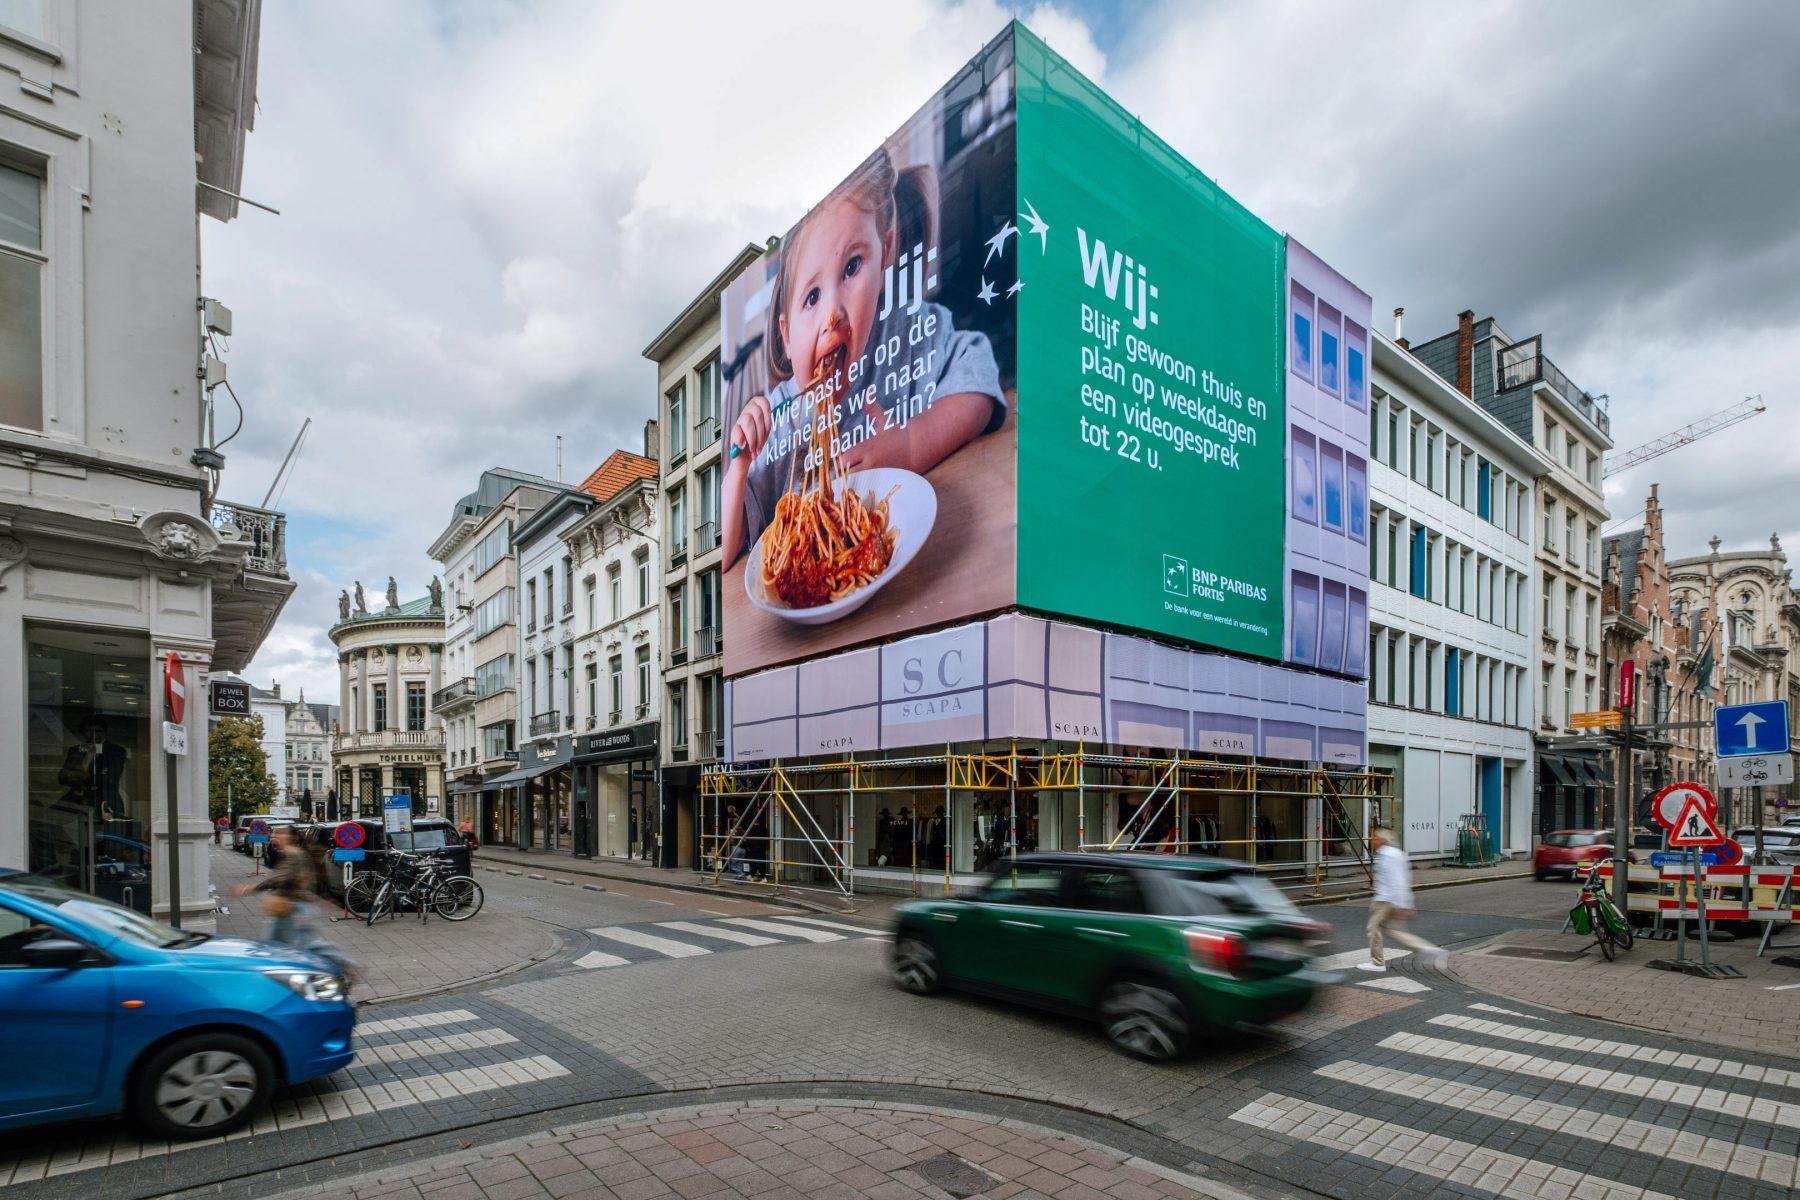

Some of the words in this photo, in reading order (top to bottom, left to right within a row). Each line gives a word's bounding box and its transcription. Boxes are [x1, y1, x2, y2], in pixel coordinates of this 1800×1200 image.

[880, 242, 937, 320] Jij:
[1076, 226, 1158, 330] Wij:
[771, 400, 800, 432] Wie
[804, 369, 842, 416] past
[848, 354, 868, 382] er
[874, 336, 900, 366] op
[908, 314, 936, 346] de
[1082, 303, 1120, 350] Blijf
[1126, 334, 1196, 387] gewoon
[1202, 370, 1242, 409] thuis
[1248, 396, 1266, 420] en
[766, 423, 812, 466] kleine
[817, 404, 842, 434] als
[848, 383, 877, 414] we
[885, 350, 936, 395] naar
[1082, 346, 1126, 387] plan
[1132, 372, 1154, 404] op
[1160, 386, 1257, 446] weekdagen
[804, 445, 824, 472] de
[830, 414, 877, 458] bank
[884, 381, 937, 431] zijn?
[1080, 416, 1110, 450] tot
[1117, 430, 1140, 462] 22
[1148, 448, 1162, 472] u.
[1081, 383, 1116, 418] een
[1123, 402, 1240, 470] videogesprek
[1192, 568, 1218, 586] BNP
[1220, 576, 1267, 601] PARIBAS
[1193, 584, 1224, 602] FORTIS
[1164, 601, 1172, 610] De
[1174, 604, 1188, 614] bank
[1189, 608, 1202, 617] voor
[1203, 612, 1213, 620] een
[1214, 615, 1232, 626] wereld
[1239, 621, 1268, 636] verandering
[218, 698, 244, 709] BOX
[902, 697, 962, 717] SCAPA
[590, 738, 605, 748] RIVER
[613, 734, 630, 744] WOODS
[820, 736, 854, 750] SCAPA
[1054, 722, 1098, 737] SCAPA
[1212, 738, 1244, 750] SCAPA
[1410, 822, 1434, 830] SCAPA
